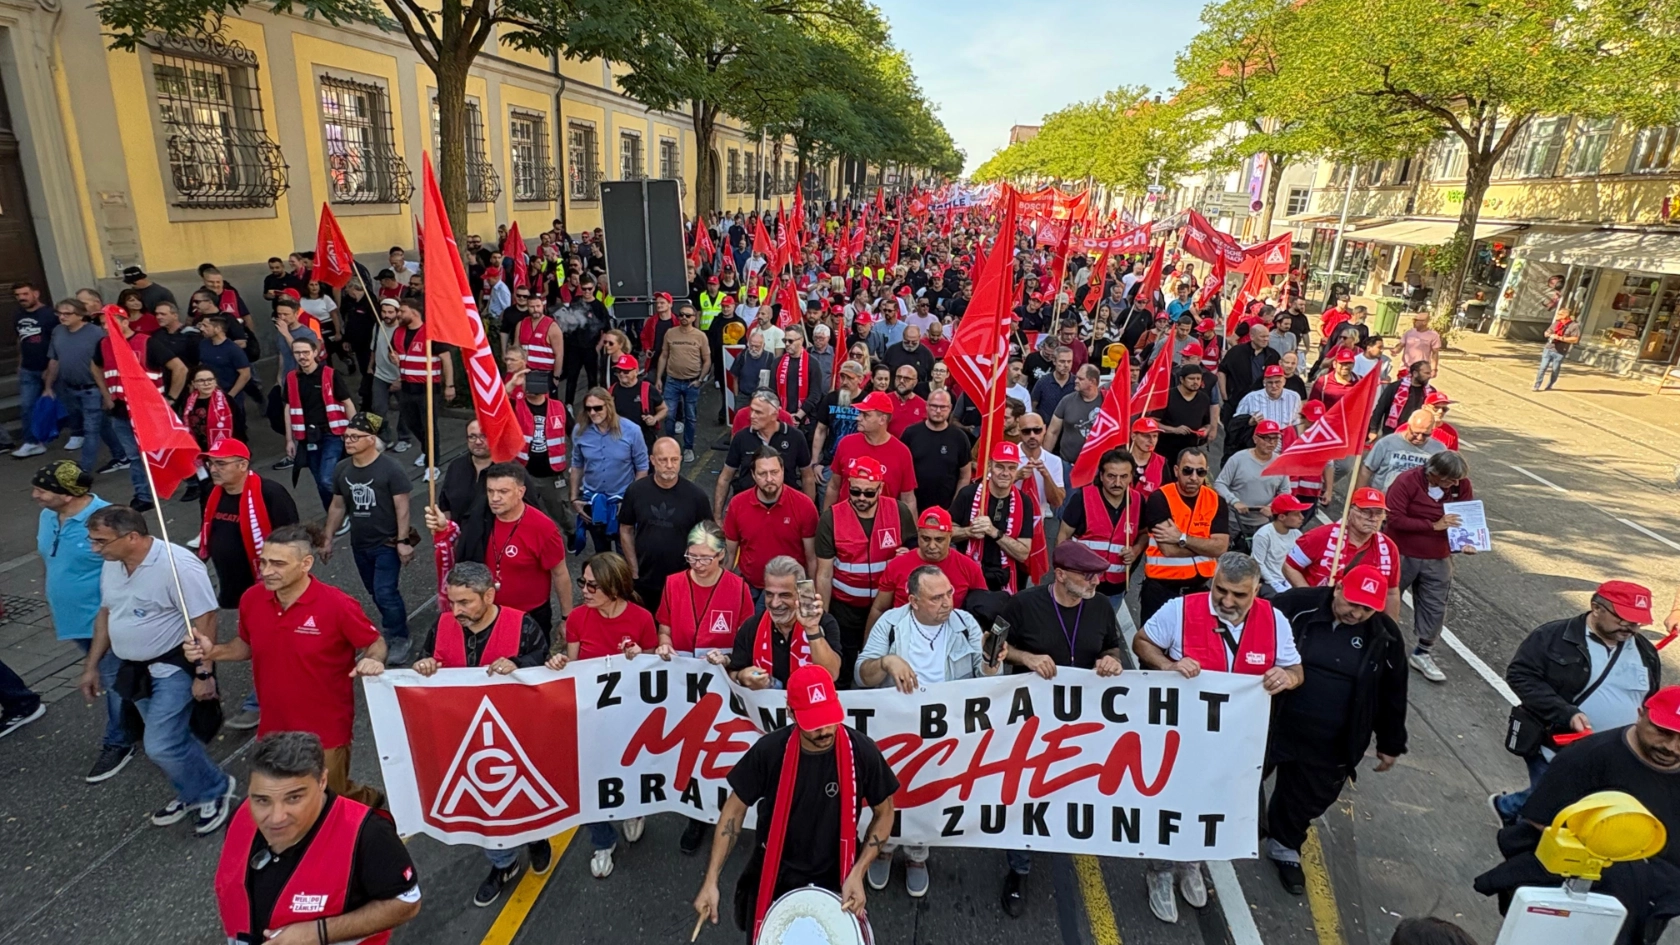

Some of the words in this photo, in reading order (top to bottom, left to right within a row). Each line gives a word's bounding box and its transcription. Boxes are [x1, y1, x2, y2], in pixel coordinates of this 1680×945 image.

[829, 405, 860, 416] WACKE
[1392, 453, 1428, 464] RACIN
[597, 669, 875, 734] ZUKUNT
[920, 685, 1230, 739] BRAUCHT
[941, 801, 1226, 847] ZUKUNFT
